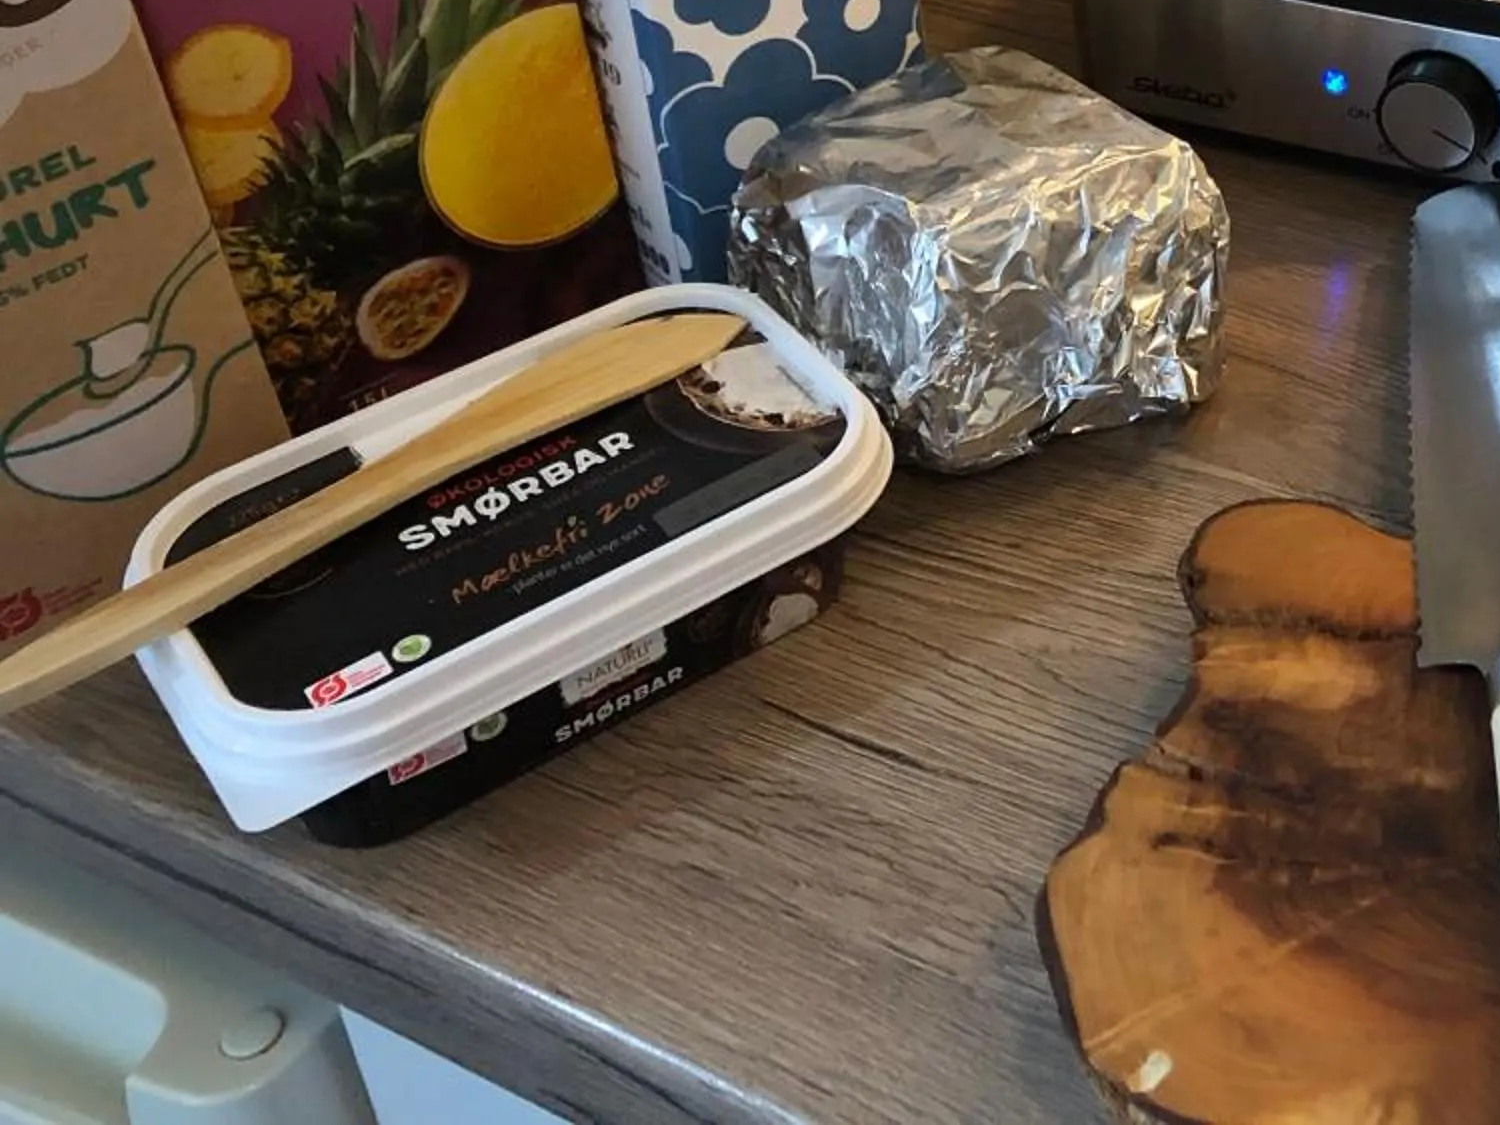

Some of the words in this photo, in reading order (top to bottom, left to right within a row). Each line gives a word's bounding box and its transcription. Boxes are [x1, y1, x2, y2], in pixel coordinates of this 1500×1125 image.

[32, 252, 89, 291] FEDT
[398, 431, 636, 551] SMØRBAR
[554, 666, 684, 743] SMØRBAR
